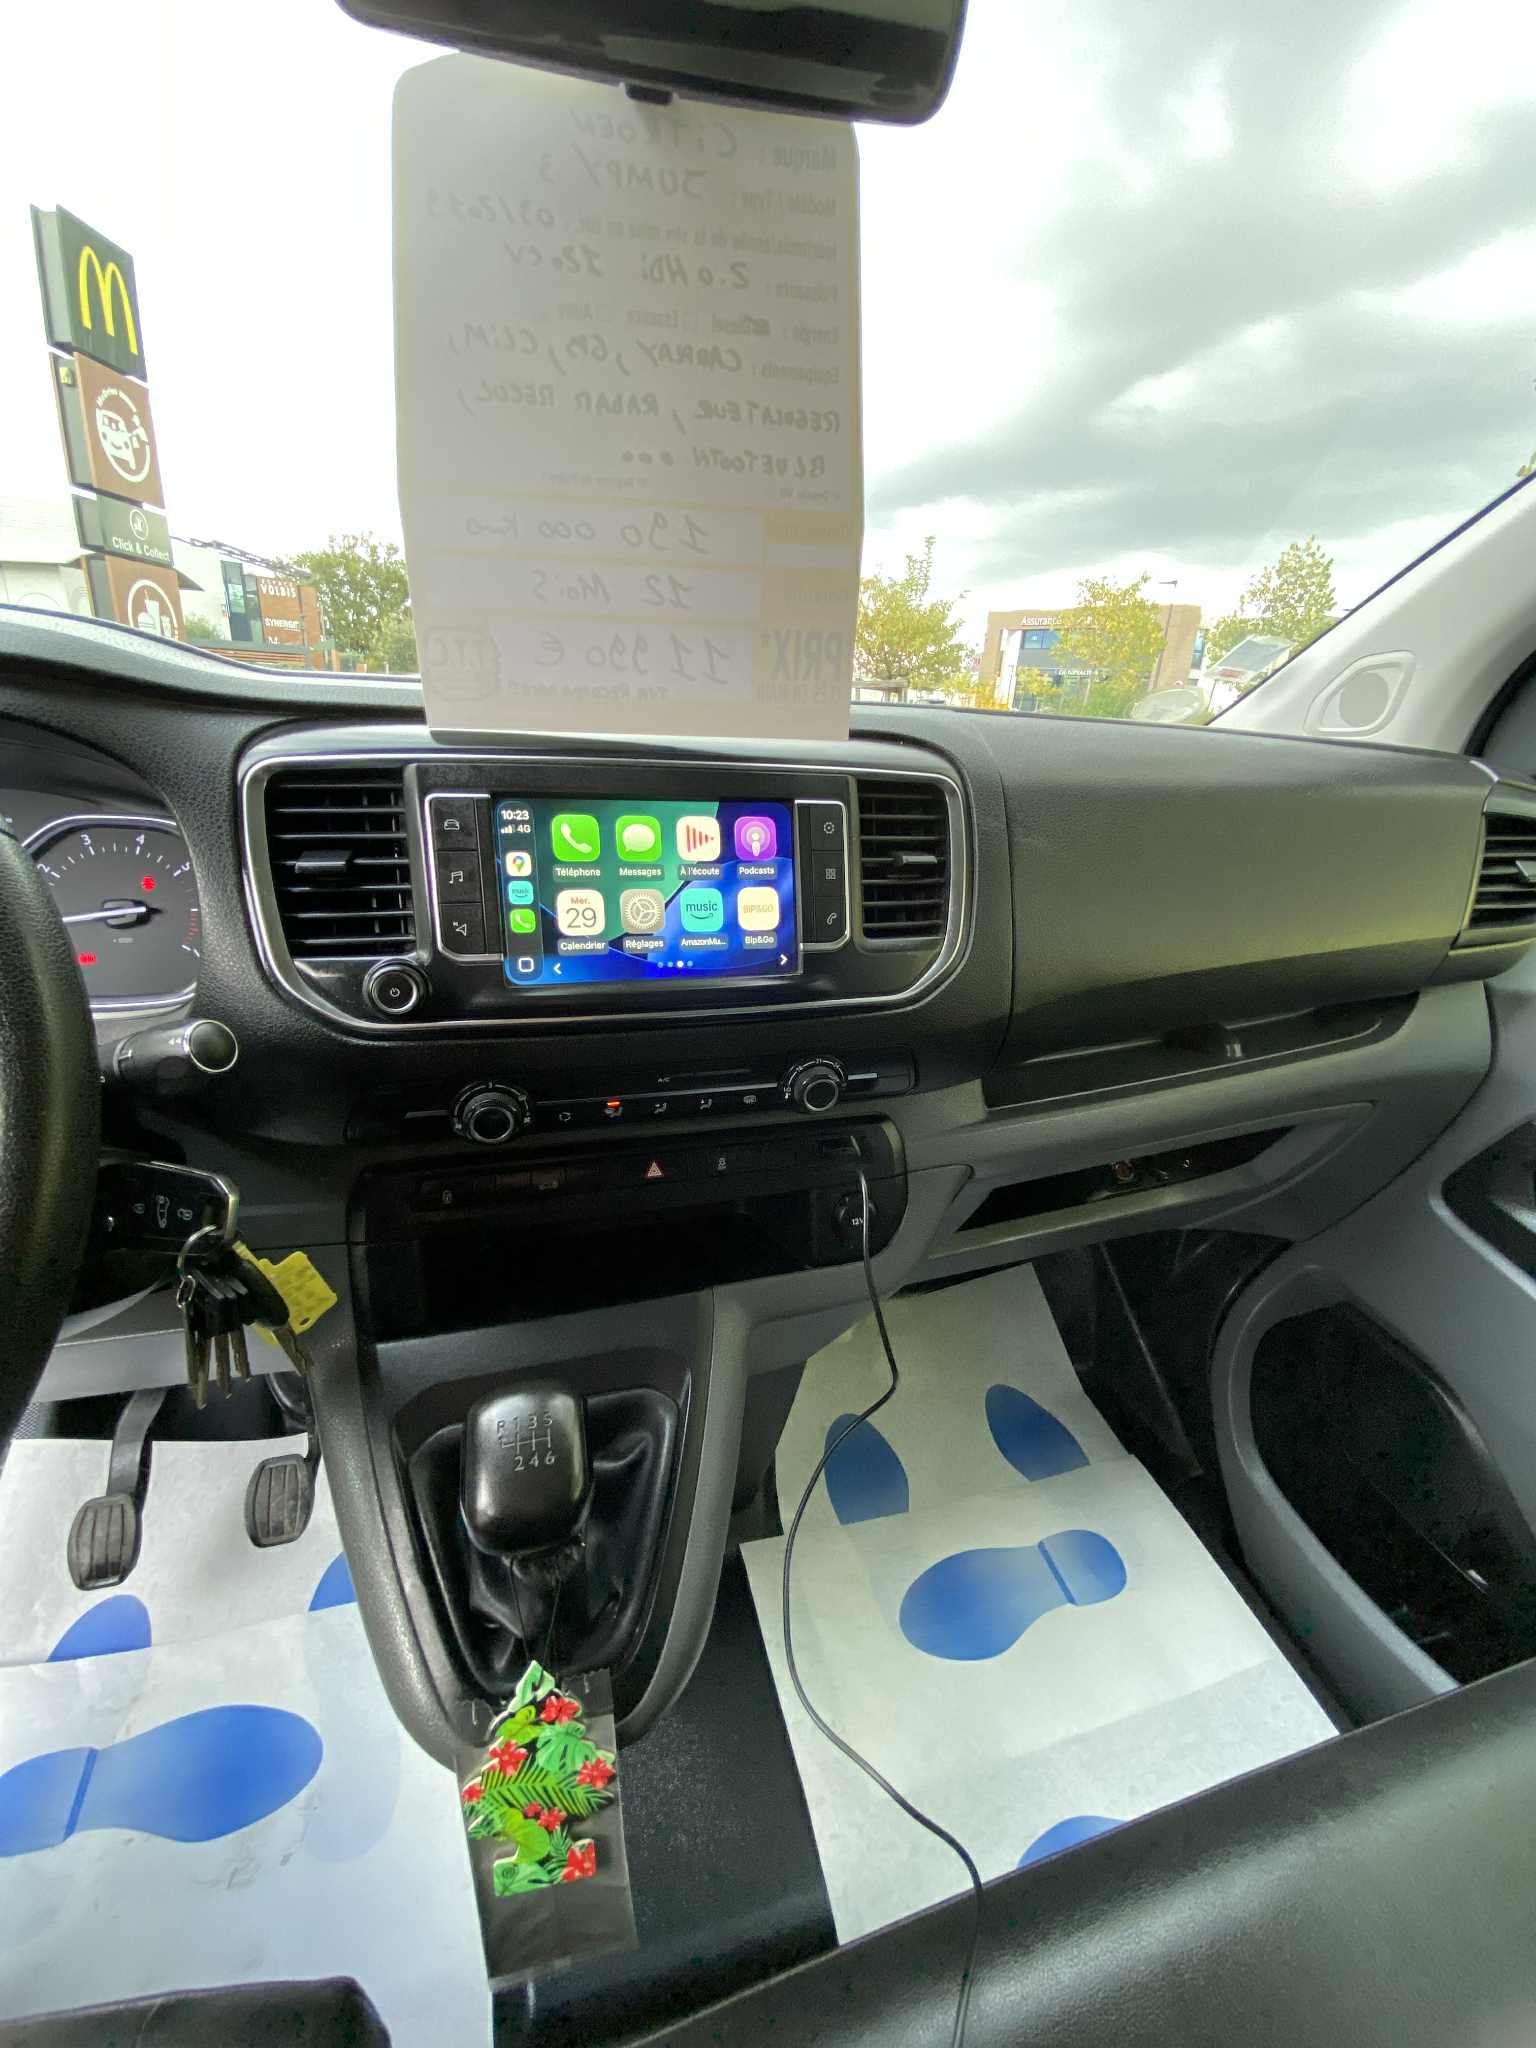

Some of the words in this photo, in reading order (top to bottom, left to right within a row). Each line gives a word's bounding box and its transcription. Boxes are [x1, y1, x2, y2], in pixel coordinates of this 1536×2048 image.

[501, 810, 529, 821] 10:23
[517, 825, 531, 833] 4G
[81, 834, 92, 846] 3
[136, 834, 145, 844] 4
[555, 867, 601, 877] Téléphone
[619, 866, 662, 877] Messages
[739, 866, 775, 875] Podcasts
[686, 901, 718, 912] music
[565, 907, 597, 928] 29
[560, 941, 606, 951] Calendrier
[625, 939, 664, 950] Réglages
[514, 1456, 525, 1472] 2
[529, 1454, 539, 1468] 4
[545, 1451, 556, 1465] 6
